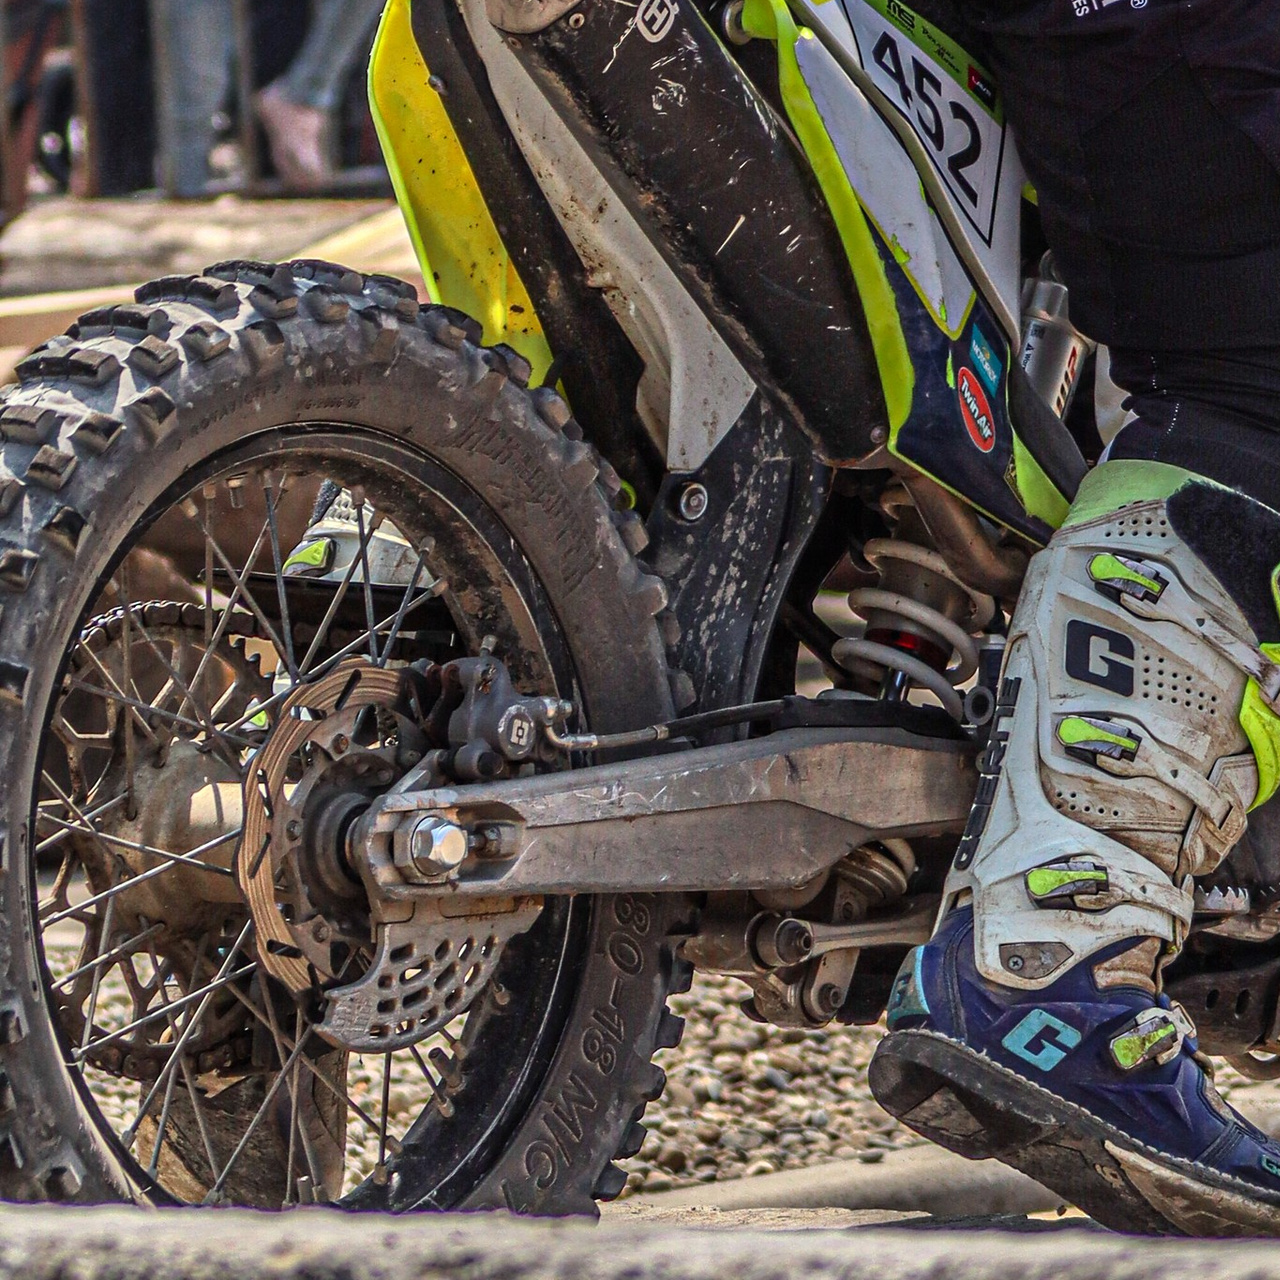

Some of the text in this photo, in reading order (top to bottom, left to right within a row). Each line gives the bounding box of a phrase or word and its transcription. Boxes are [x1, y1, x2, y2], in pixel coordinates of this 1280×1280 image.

[872, 30, 982, 207] 452
[960, 376, 993, 439] Twin Air
